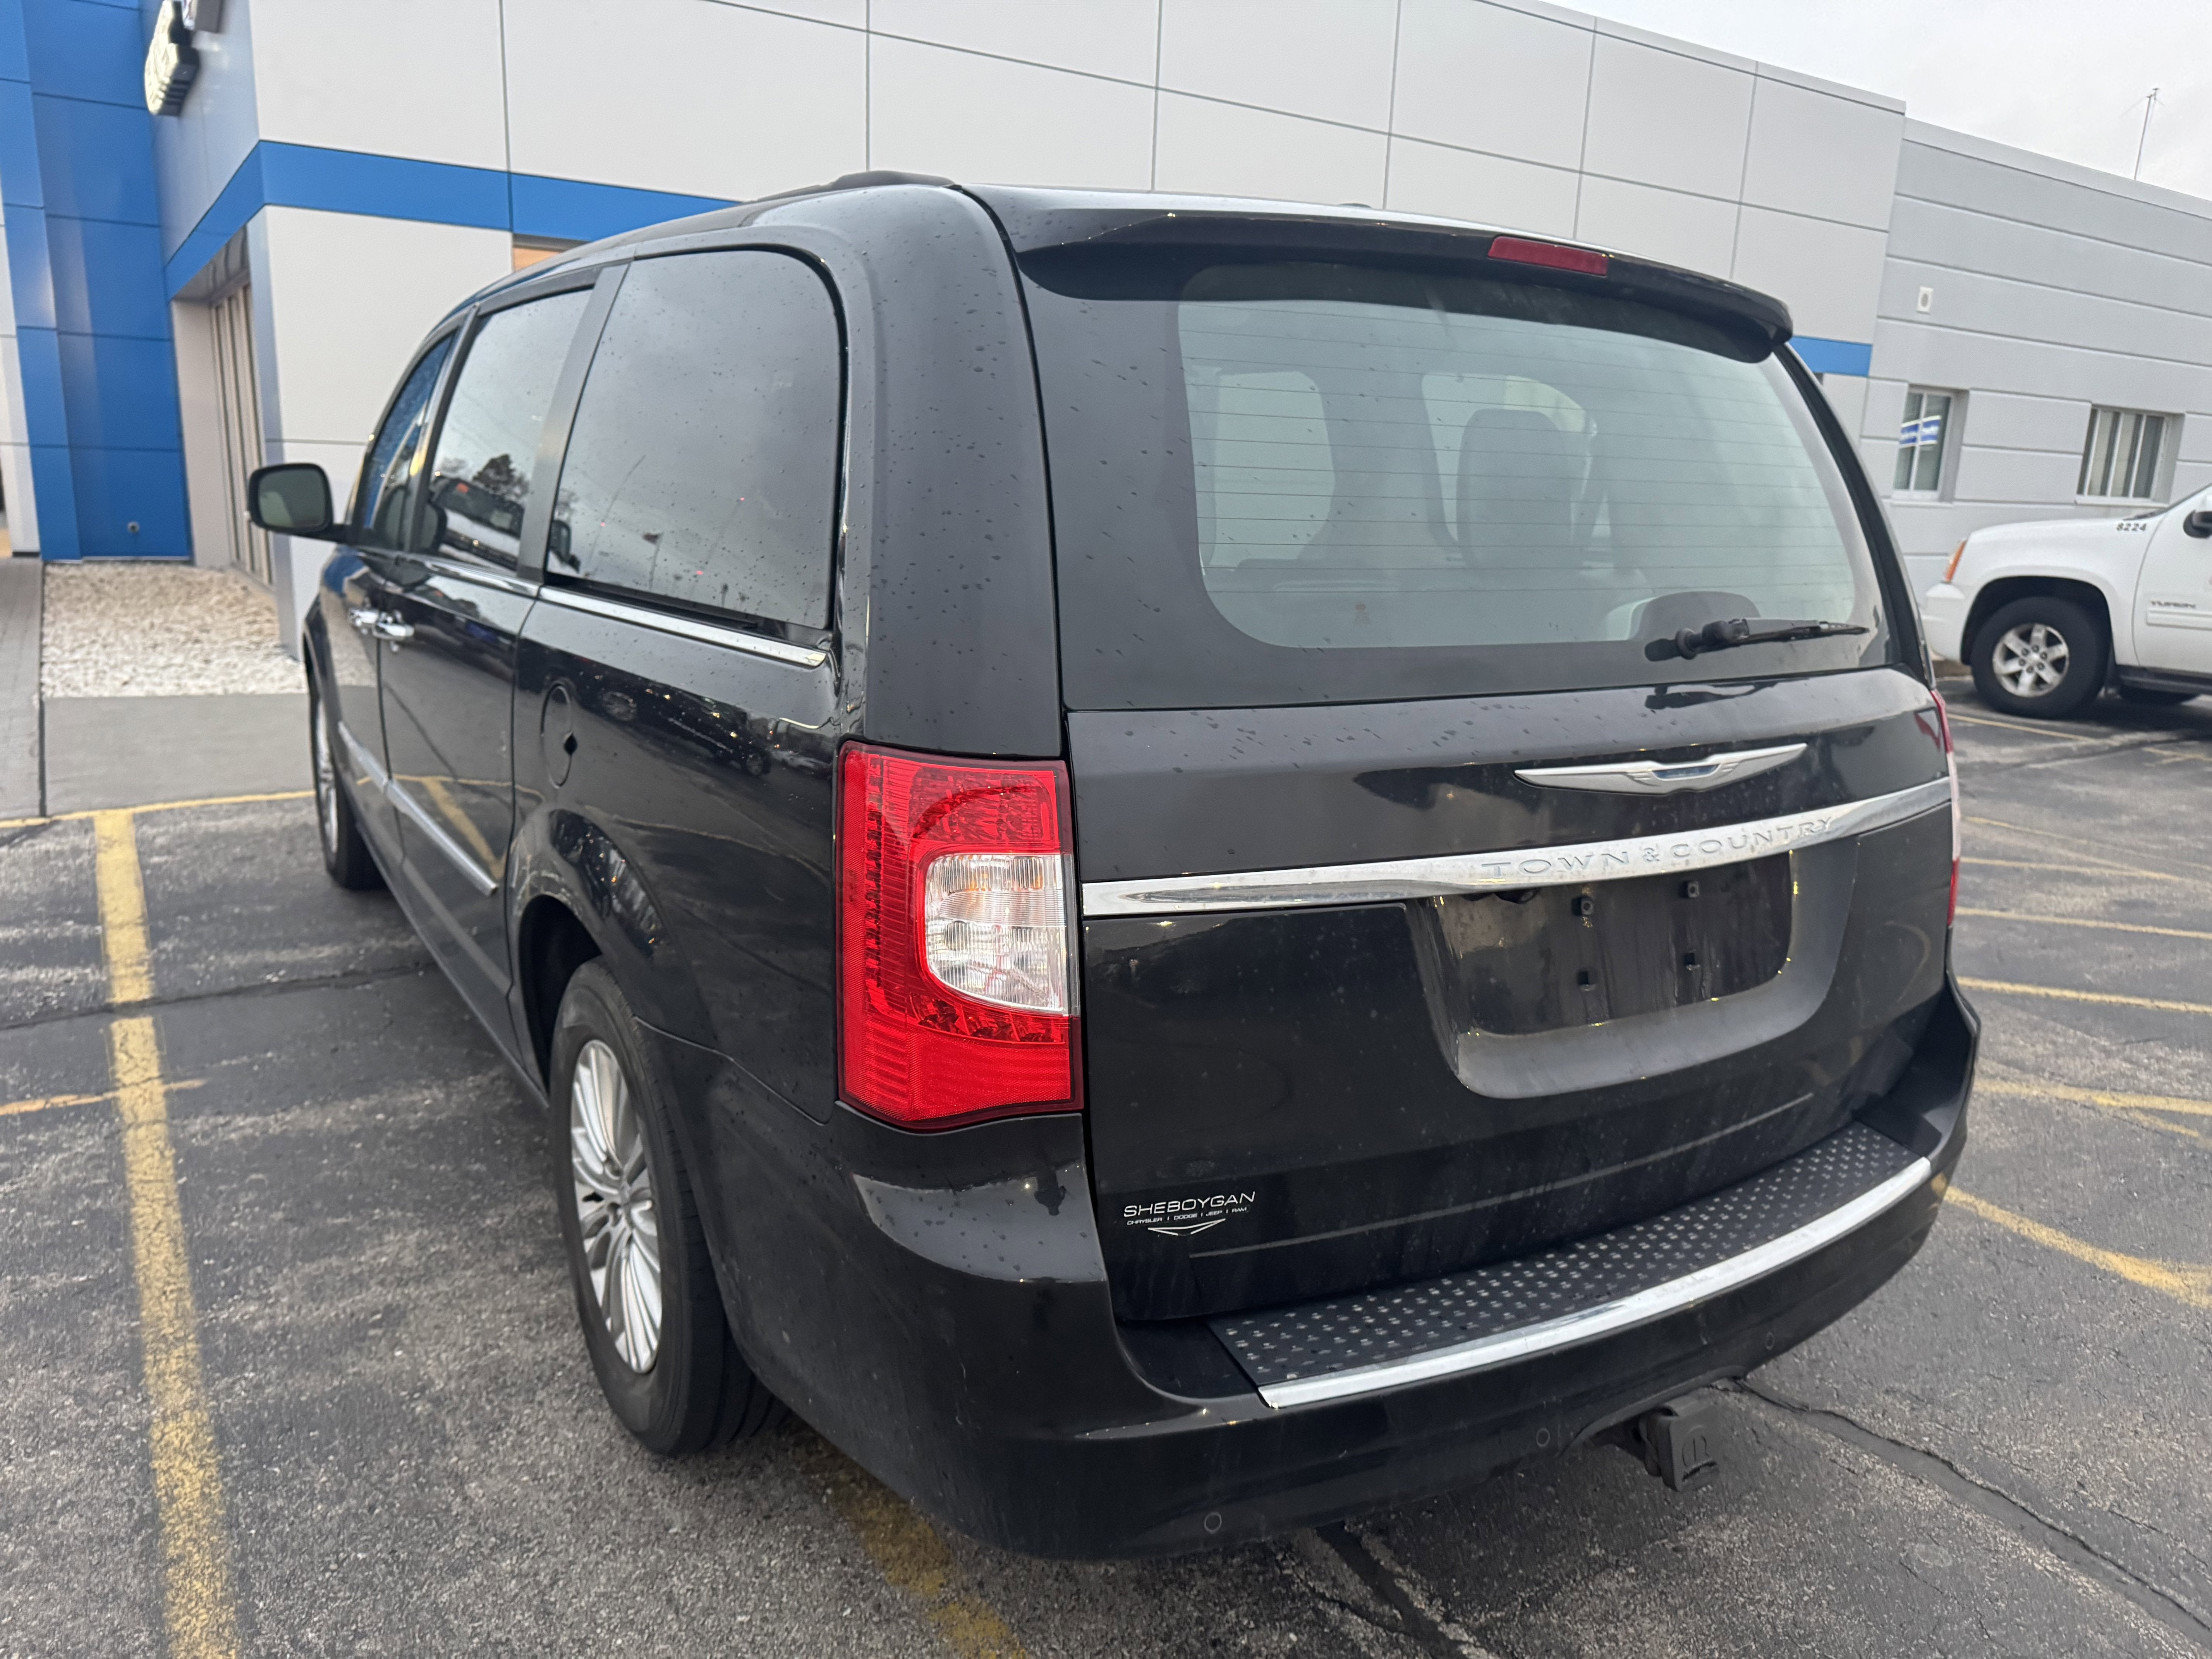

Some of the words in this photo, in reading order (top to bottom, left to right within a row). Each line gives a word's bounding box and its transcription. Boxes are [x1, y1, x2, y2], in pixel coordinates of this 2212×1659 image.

[2116, 522, 2147, 532] 8224
[1481, 851, 1629, 878] TOWN
[1642, 847, 1660, 862] &
[1670, 816, 1832, 857] COUNTRY
[1123, 1191, 1255, 1217] SHEBOYGAN
[1127, 1217, 1162, 1225] CHRYSLER
